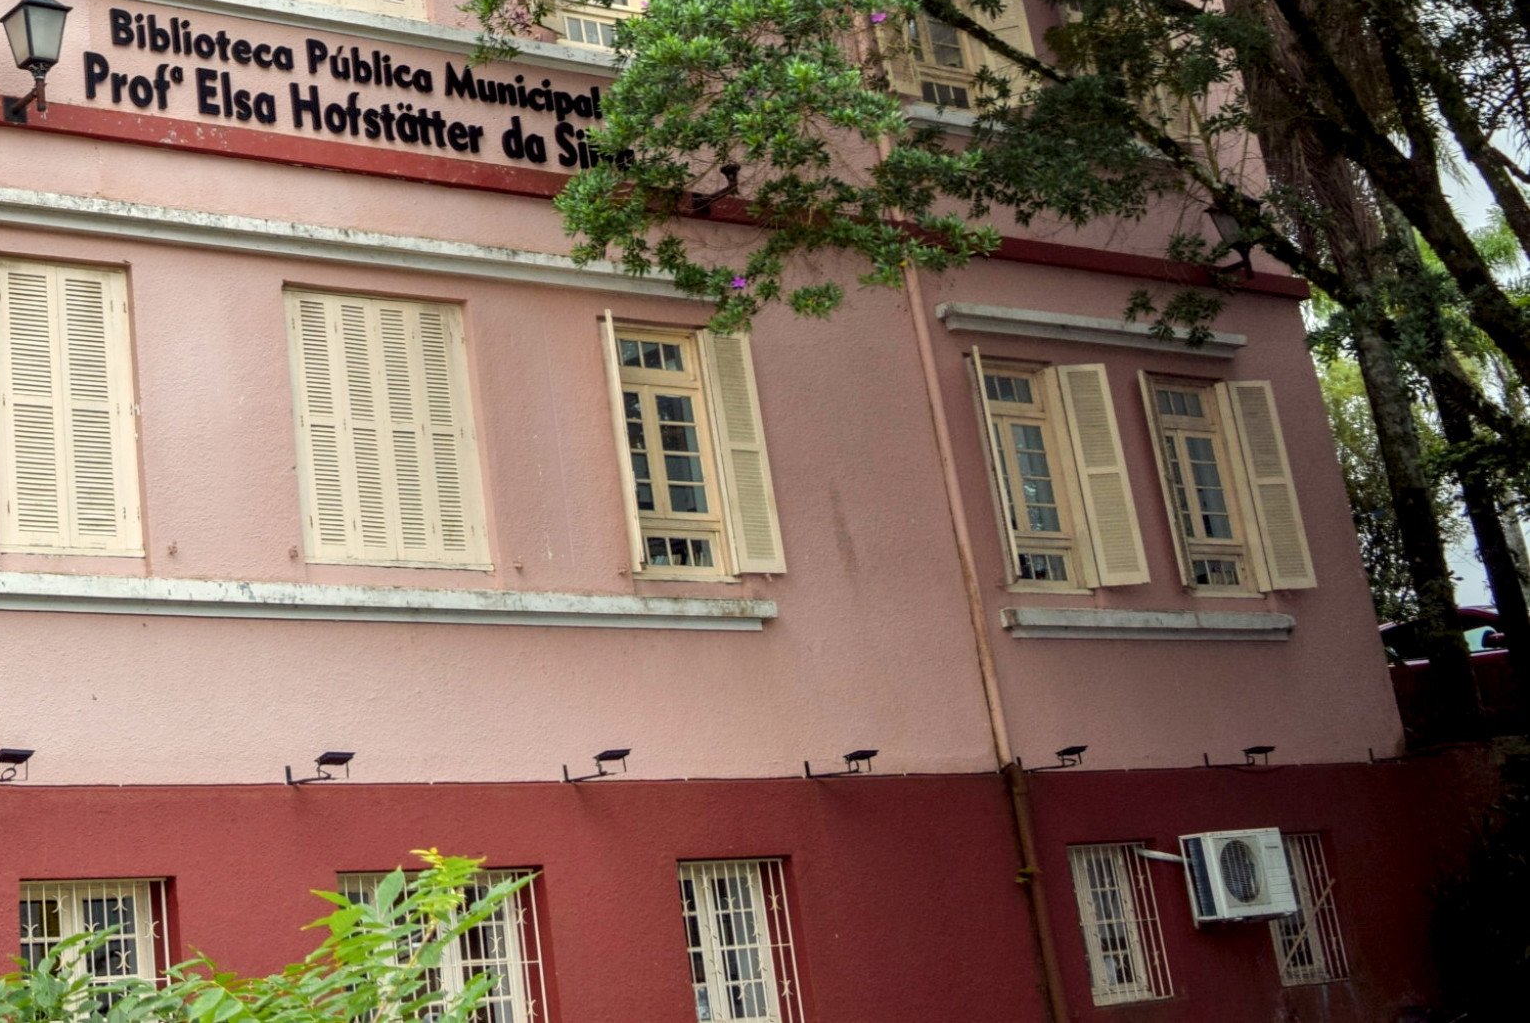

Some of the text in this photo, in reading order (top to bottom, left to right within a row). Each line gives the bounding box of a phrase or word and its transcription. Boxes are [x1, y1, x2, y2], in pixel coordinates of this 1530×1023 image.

[109, 7, 603, 121] Biblioteca Pública Municipal
[195, 67, 277, 124] Elsa
[290, 82, 484, 154] Hofstätter
[502, 115, 548, 163] da
